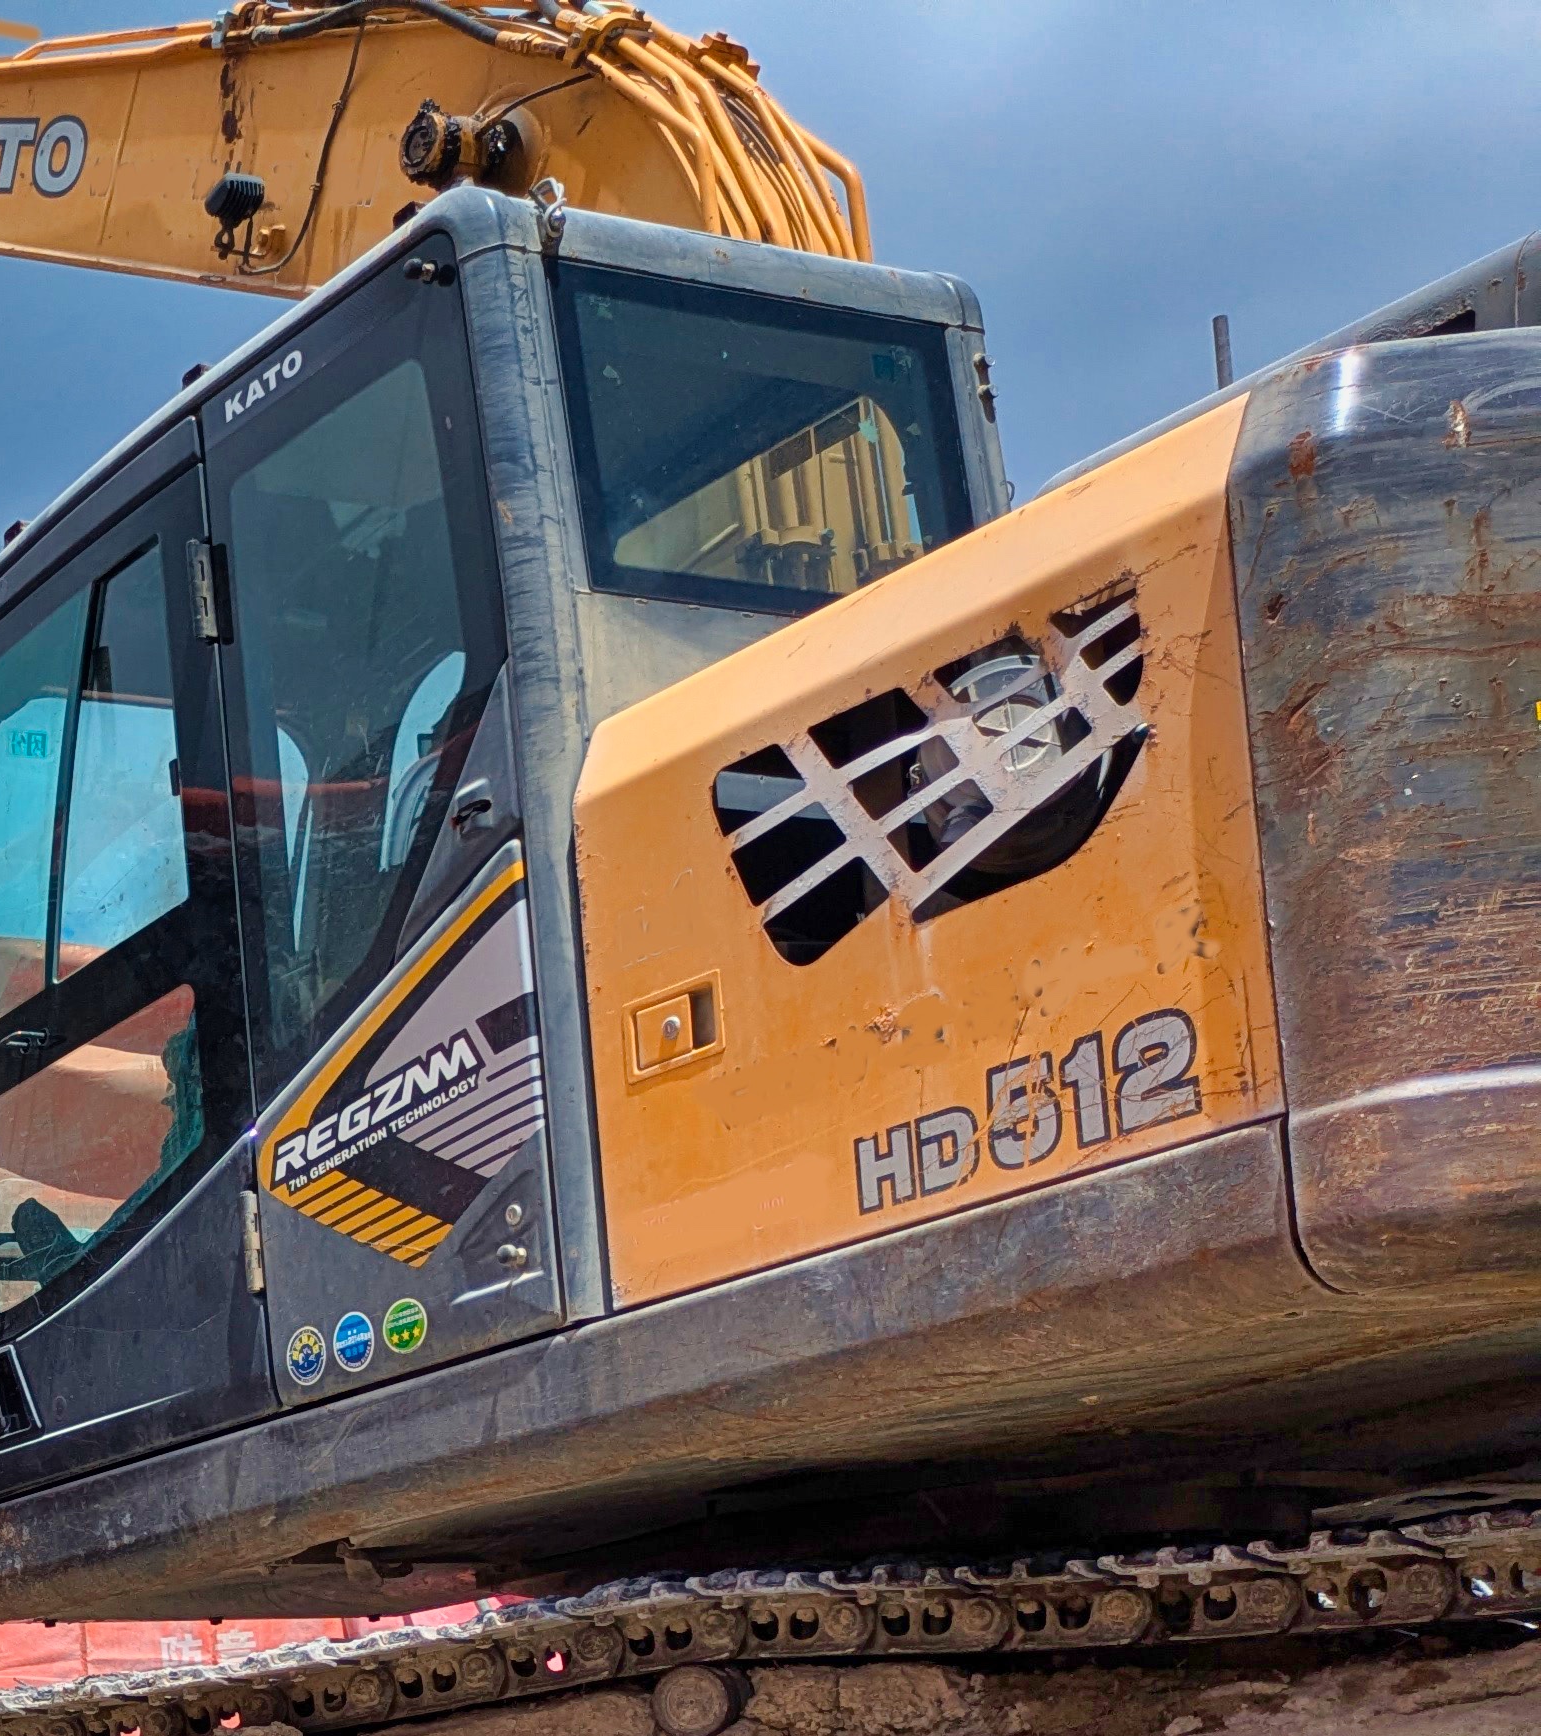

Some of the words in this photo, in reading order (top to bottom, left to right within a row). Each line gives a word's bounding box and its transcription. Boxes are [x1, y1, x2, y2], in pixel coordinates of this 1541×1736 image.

[224, 350, 303, 423] KATO
[288, 1174, 308, 1192] 7th
[309, 1126, 387, 1180] GENERATION
[389, 1073, 478, 1133] TECHNOLOGY
[854, 1007, 1203, 1216] HD512
